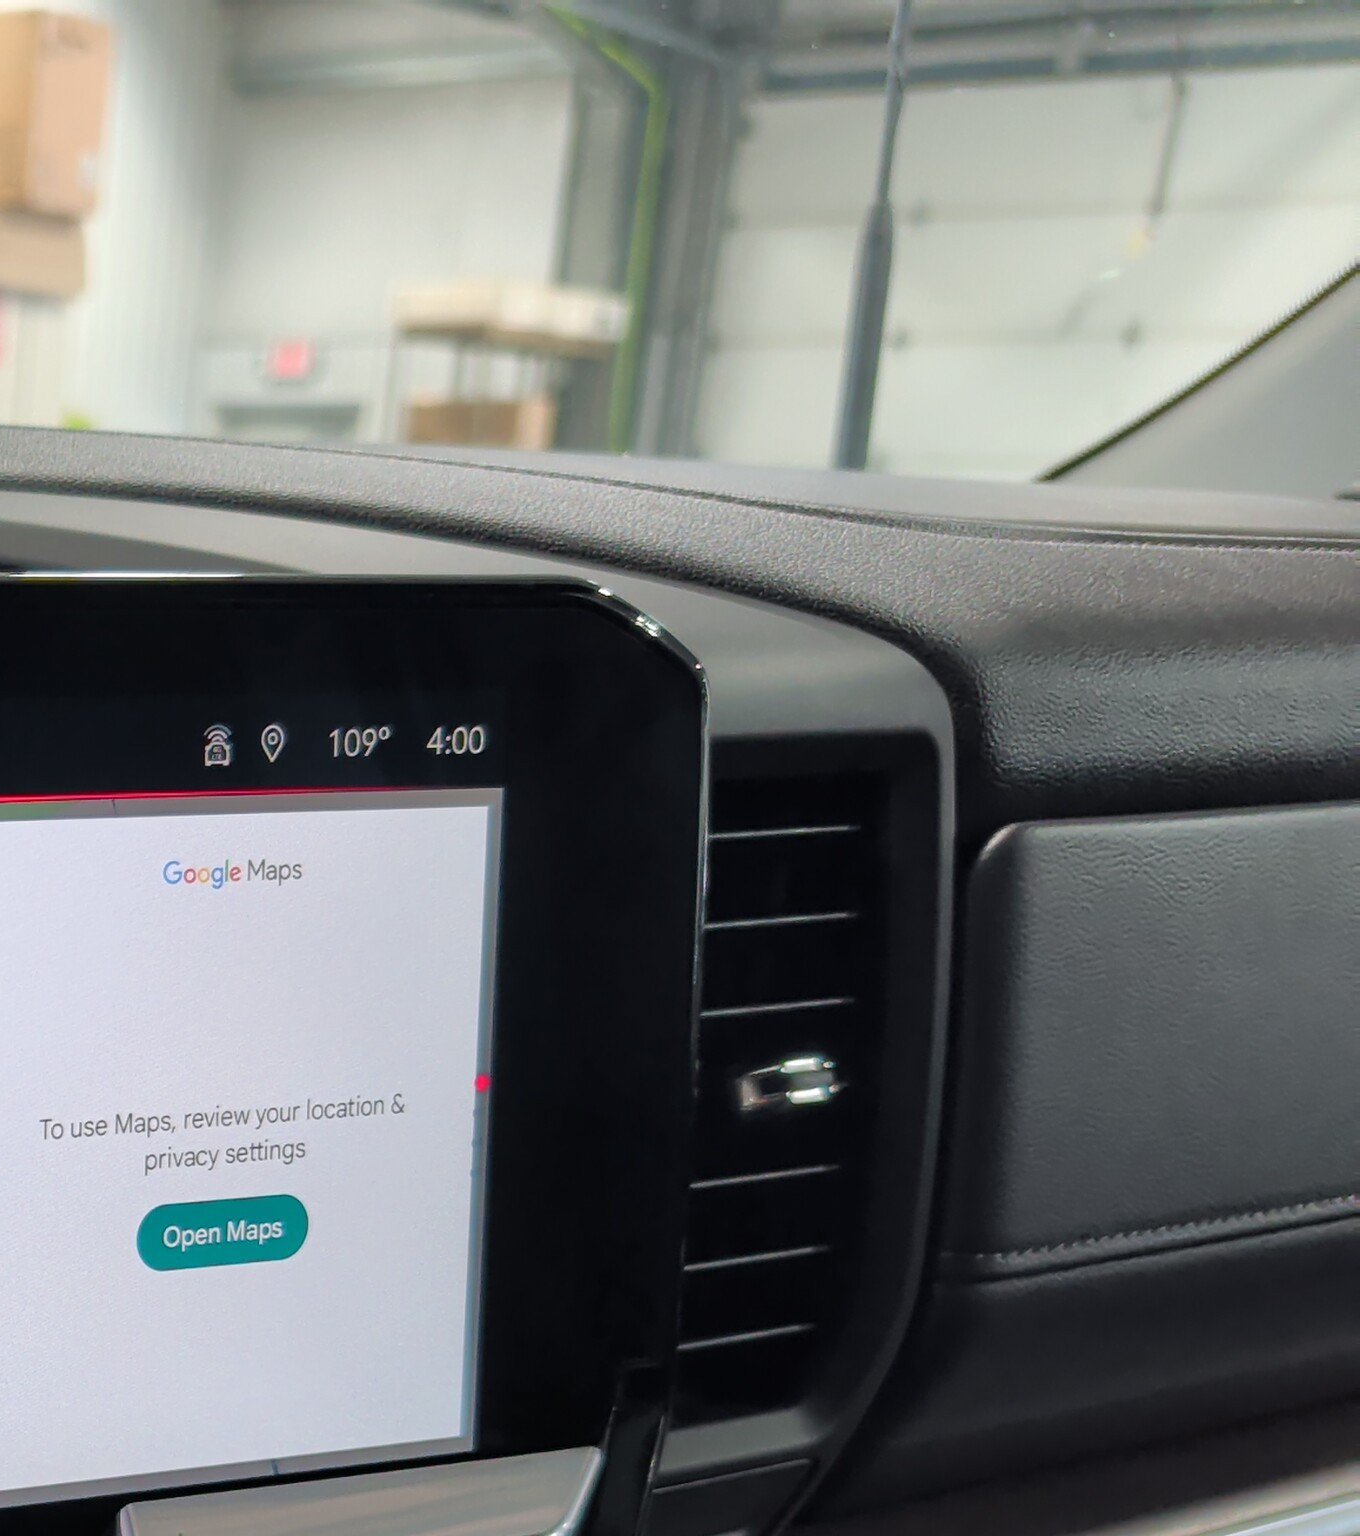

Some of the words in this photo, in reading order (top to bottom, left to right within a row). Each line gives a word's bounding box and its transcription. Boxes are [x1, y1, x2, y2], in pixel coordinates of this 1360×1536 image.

[329, 726, 392, 758] 109°
[426, 725, 485, 755] 4:00
[162, 859, 242, 890] Google
[247, 858, 303, 887] Maps
[40, 1117, 64, 1140] To
[70, 1118, 108, 1139] use
[114, 1110, 177, 1138] Maps,
[183, 1104, 250, 1131] review
[256, 1103, 301, 1128] your
[306, 1094, 385, 1121] location
[391, 1093, 406, 1114] &
[144, 1145, 220, 1176] privacy
[225, 1139, 307, 1165] settings
[162, 1225, 221, 1252] Open
[227, 1218, 284, 1246] Maps
